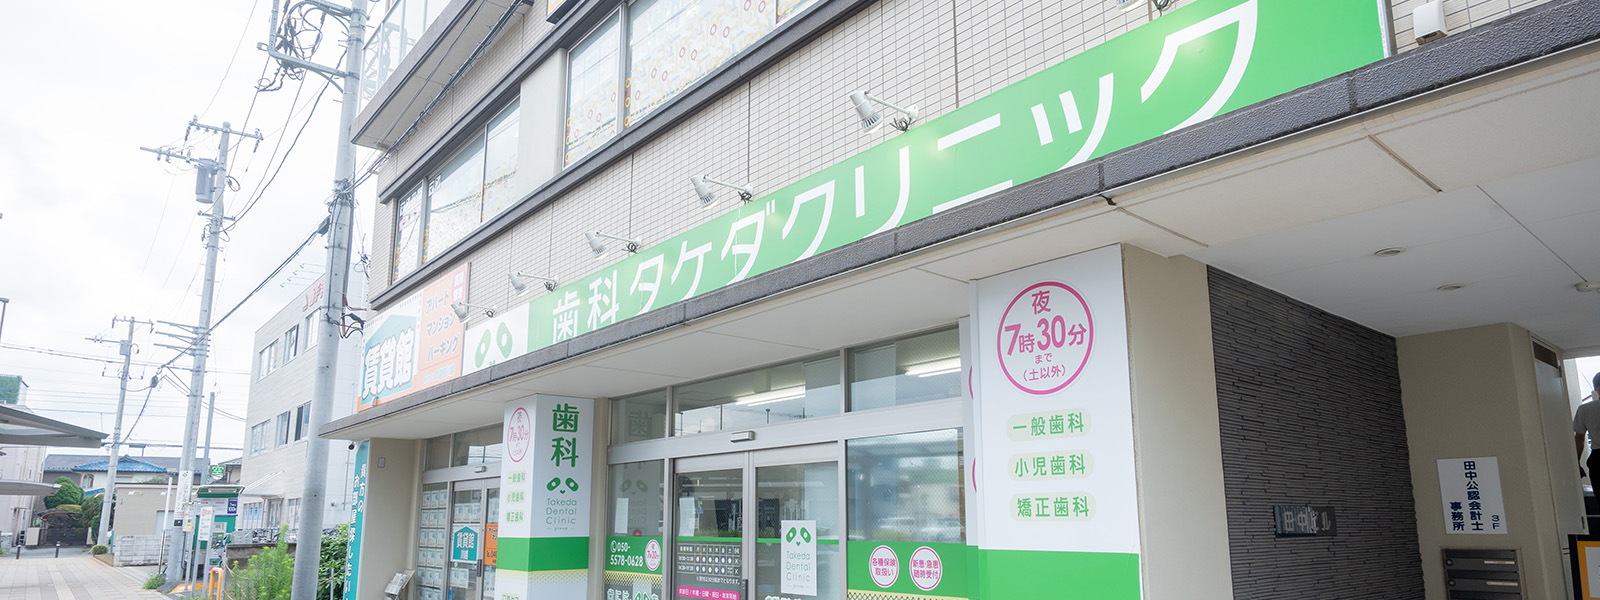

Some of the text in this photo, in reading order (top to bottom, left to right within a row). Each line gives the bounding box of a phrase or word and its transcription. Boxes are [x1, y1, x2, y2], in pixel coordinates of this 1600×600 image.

[425, 288, 450, 316] アパート
[1031, 289, 1052, 315] 夜
[426, 312, 456, 336] マンション
[1004, 314, 1088, 356] 7時30分
[427, 333, 460, 362] パーキング
[1034, 352, 1053, 364] まで
[1012, 412, 1084, 437] 一般歯科
[551, 403, 580, 468] 歯科
[1014, 454, 1086, 477] 小児歯科
[546, 497, 577, 507] Takeda
[1463, 460, 1484, 531] 田中公認会計士
[545, 507, 577, 516] Dental
[1017, 496, 1090, 518] 矯正歯科
[1449, 501, 1465, 531] 事務所
[545, 516, 576, 525] Clinic
[1283, 511, 1331, 532] 田中ビル
[609, 554, 644, 568] 5578-0628
[786, 551, 811, 561] Takeda
[786, 561, 811, 572] Dental
[872, 557, 897, 567] 各種保険
[786, 571, 811, 583] Clinic
[875, 567, 894, 577] 取扱い
